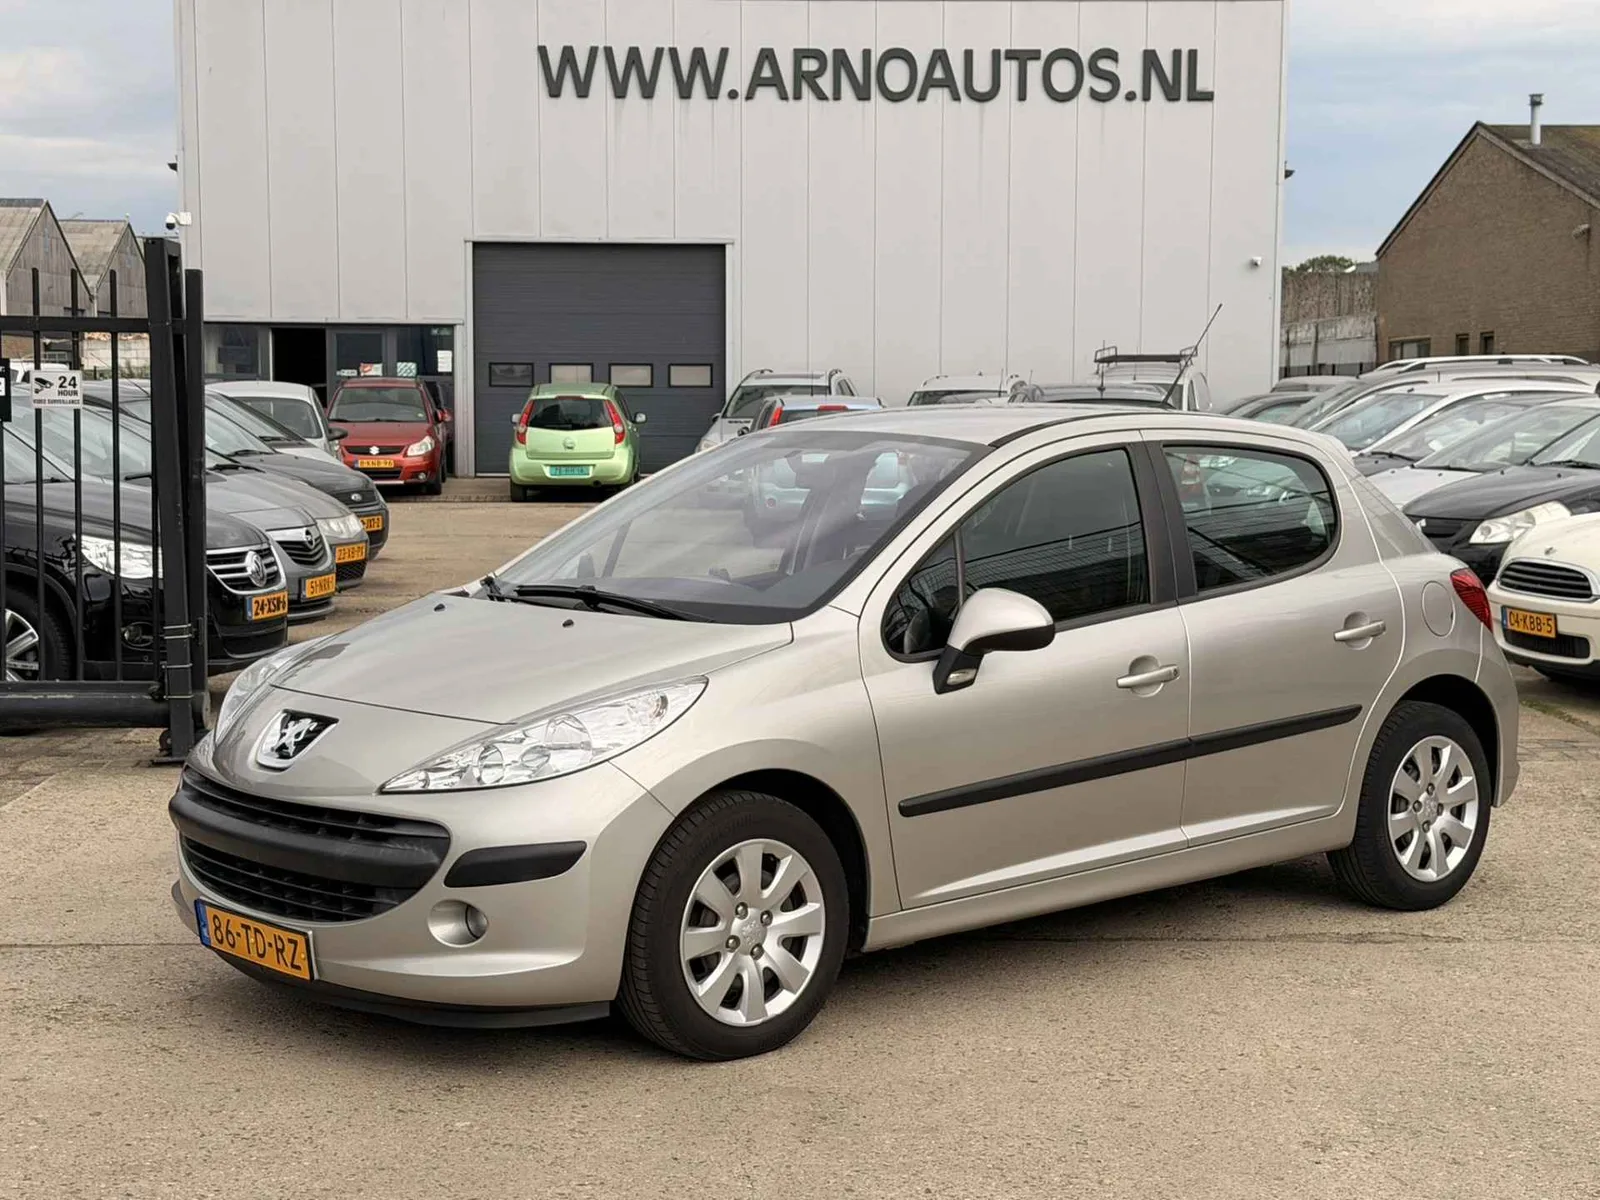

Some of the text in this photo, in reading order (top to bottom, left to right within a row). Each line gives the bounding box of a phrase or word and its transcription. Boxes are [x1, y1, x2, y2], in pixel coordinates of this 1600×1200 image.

[537, 45, 1214, 102] WWW.ARNOAUTOS.NL
[58, 376, 77, 388] 24
[212, 914, 302, 971] 86-TD-RZ
